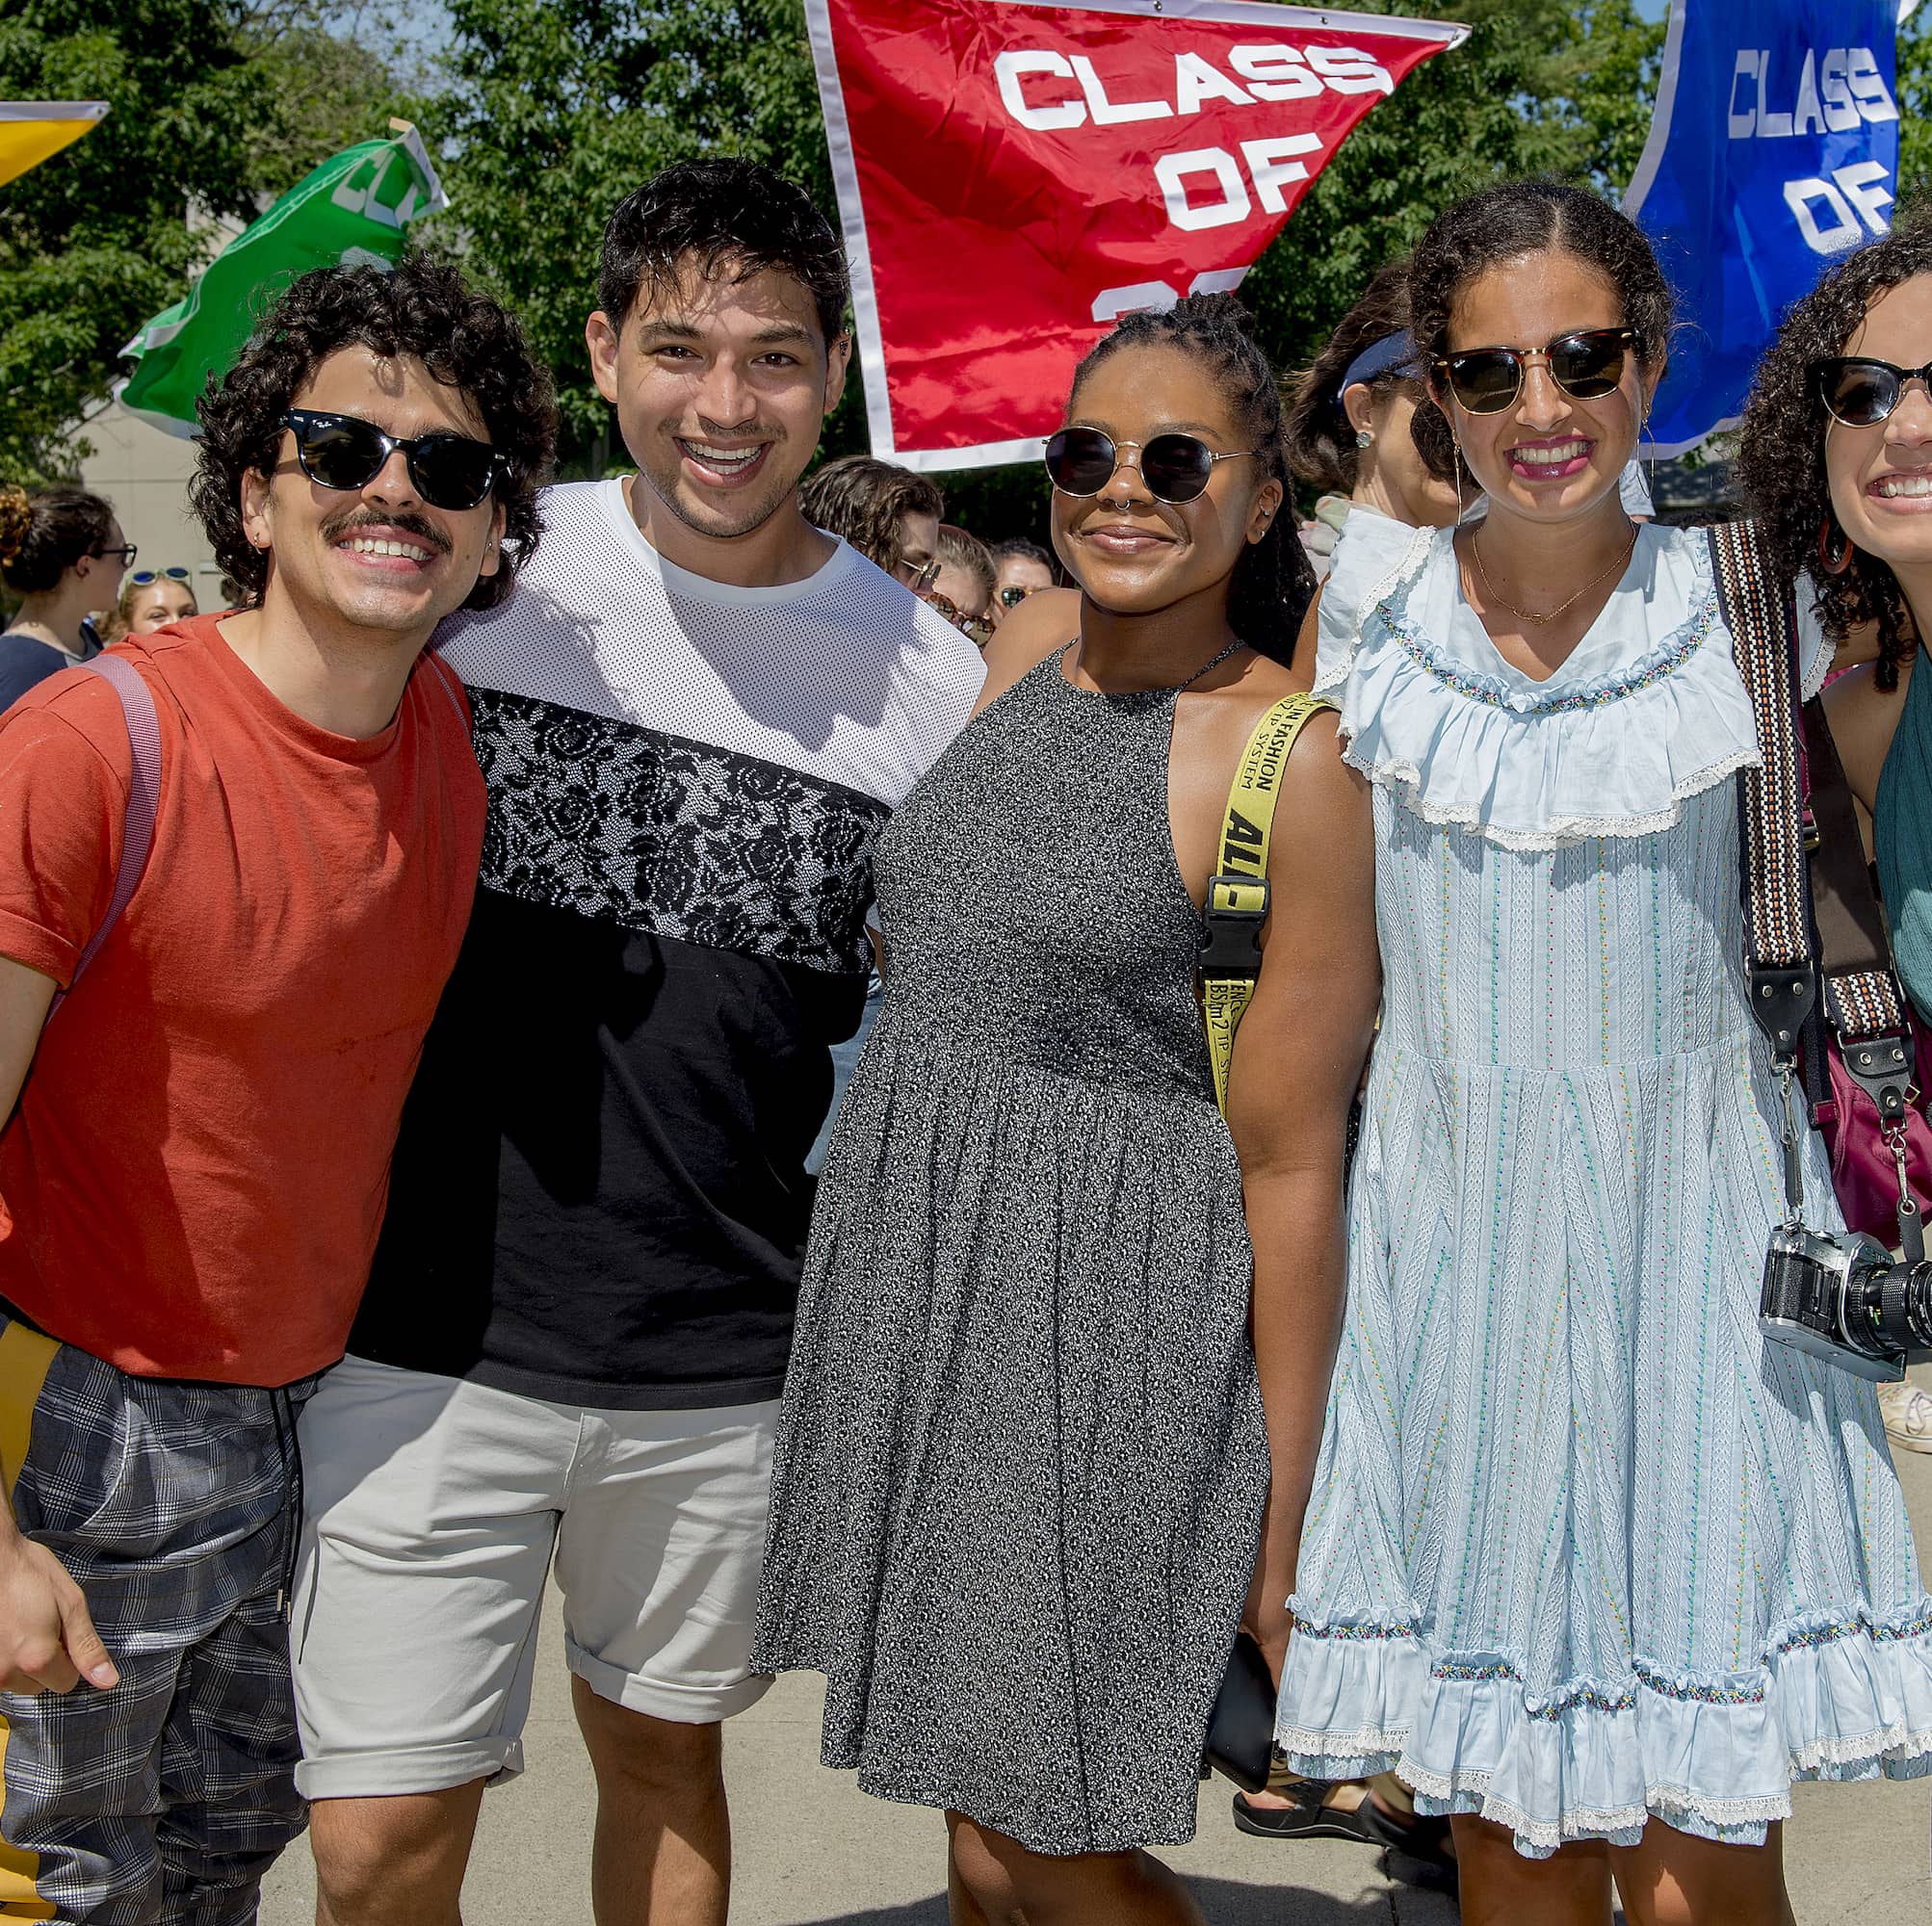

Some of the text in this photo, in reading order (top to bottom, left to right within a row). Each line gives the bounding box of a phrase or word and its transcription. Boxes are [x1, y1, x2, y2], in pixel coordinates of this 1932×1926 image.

[994, 44, 1394, 131] CLASS
[1728, 47, 1900, 139] CLASS
[1154, 132, 1324, 231] OF
[1784, 160, 1895, 255] OF
[1241, 733, 1269, 789] SYSTEM
[1256, 723, 1293, 791] FASHION
